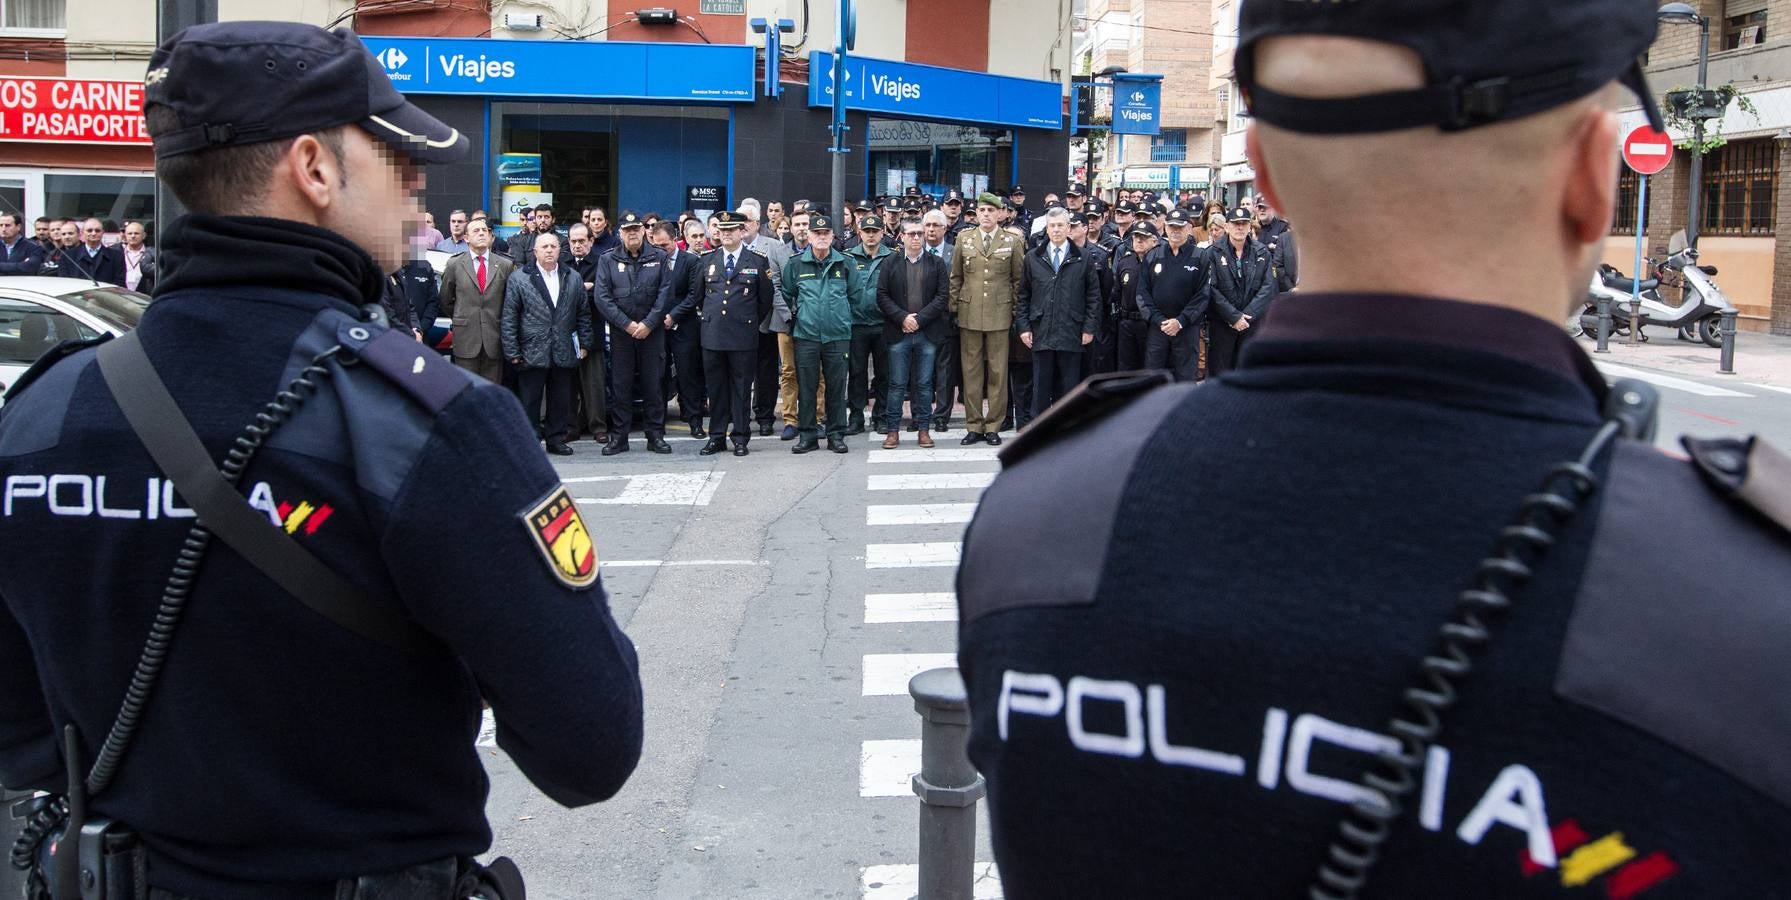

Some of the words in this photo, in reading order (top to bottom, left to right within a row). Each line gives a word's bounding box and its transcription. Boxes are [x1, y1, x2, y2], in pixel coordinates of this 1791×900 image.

[386, 71, 412, 81] refour
[439, 54, 516, 83] Viajes
[0, 80, 37, 109] OS
[51, 82, 146, 112] CARNE
[871, 74, 920, 102] Viajes
[1121, 109, 1153, 122] Viajes
[699, 187, 717, 195] MSC
[4, 474, 284, 527] POLICA
[997, 670, 1557, 868] POLICIA
